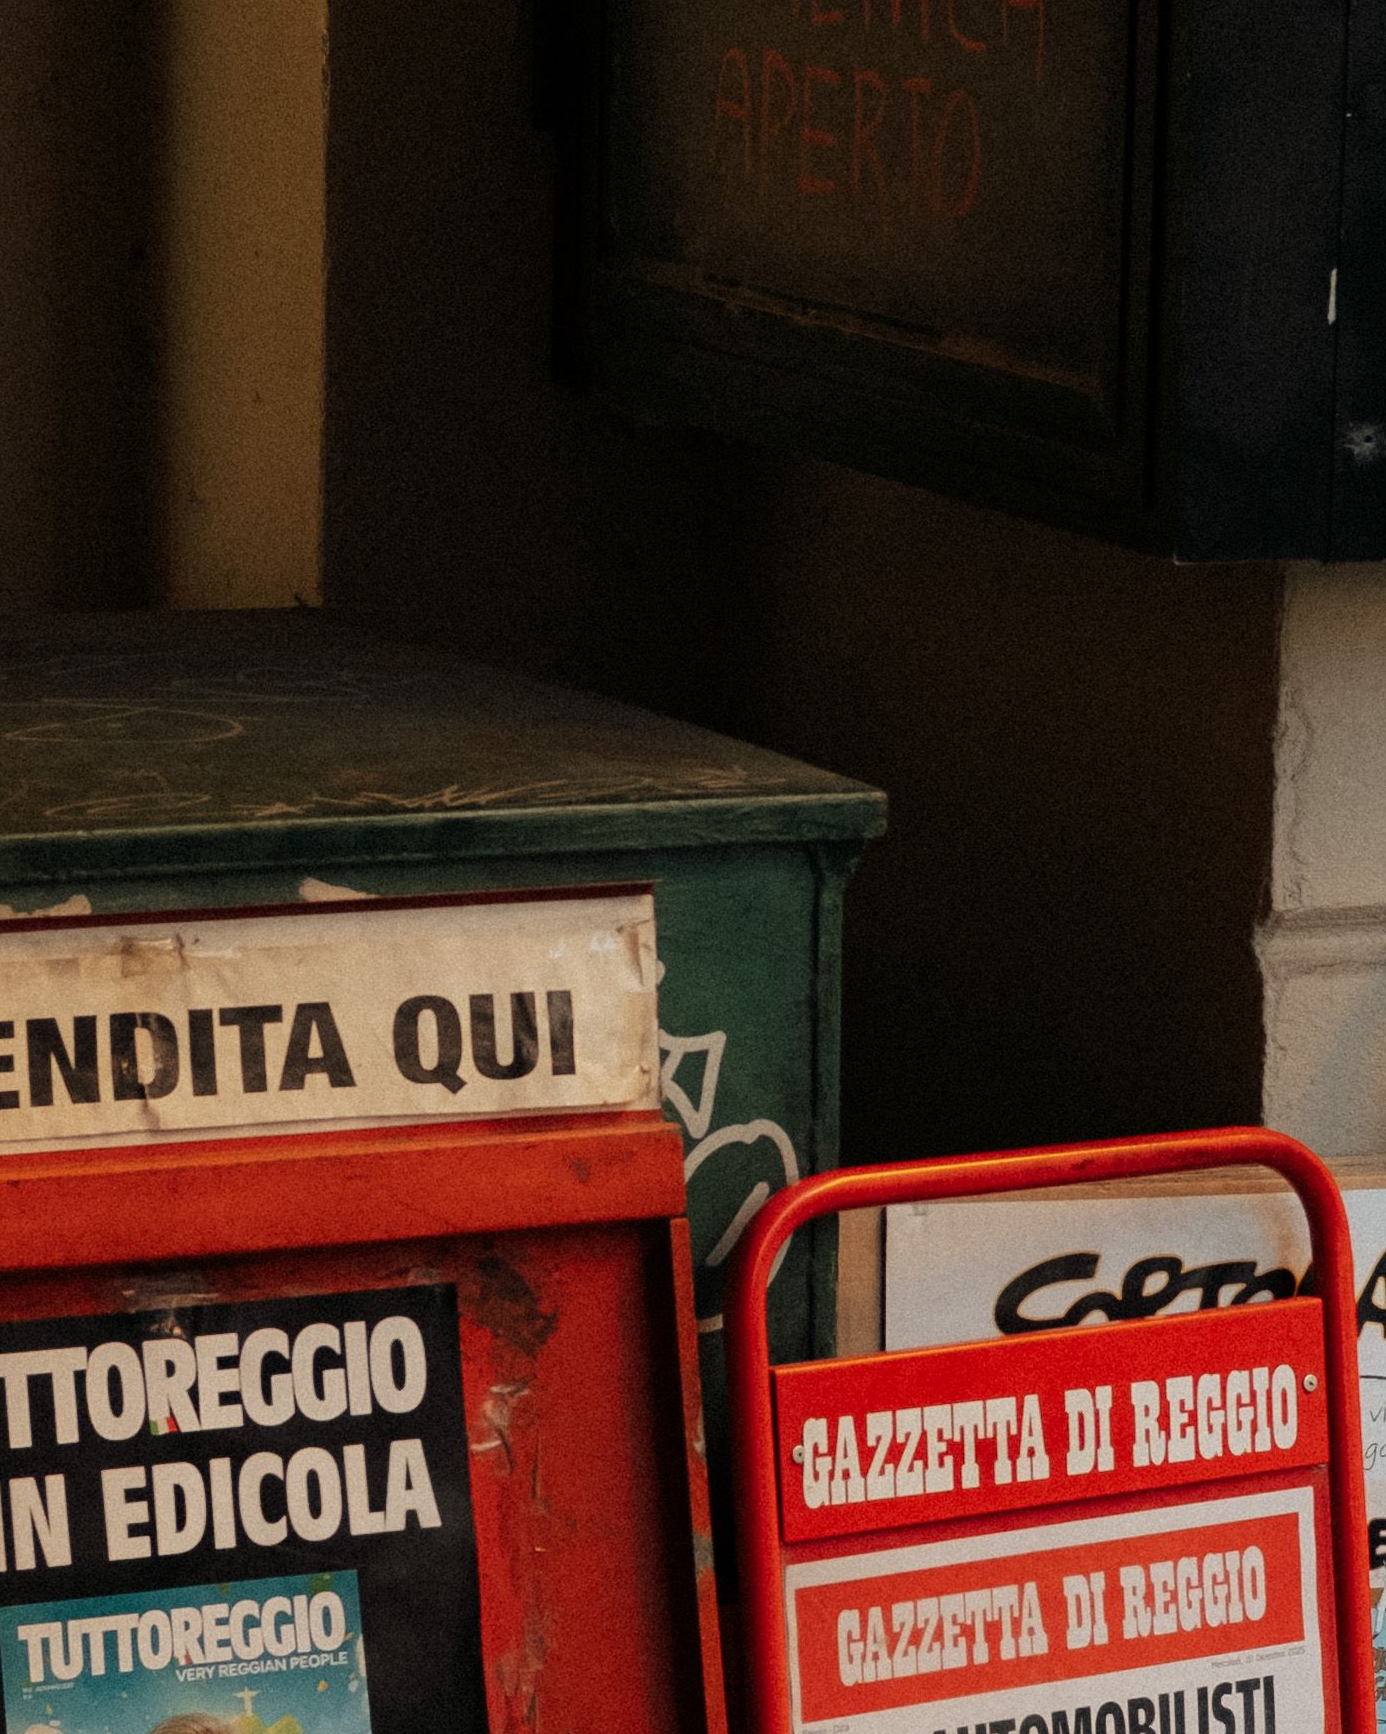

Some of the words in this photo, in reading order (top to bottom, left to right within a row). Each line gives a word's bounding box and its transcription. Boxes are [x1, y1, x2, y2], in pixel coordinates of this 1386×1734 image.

[714, 47, 981, 217] APERTO
[393, 989, 576, 1095] QUI
[803, 1396, 1049, 1509] GAZZETTA
[1065, 1386, 1115, 1476] DI
[1131, 1364, 1298, 1466] REGGIO
[104, 1439, 441, 1562] EDICOLA
[18, 1591, 346, 1683] TUTTOREGGIO
[176, 1666, 215, 1683] VERY
[219, 1658, 287, 1678] REGGIAN
[290, 1652, 348, 1669] PEOPLE
[837, 1583, 1048, 1687] GAZZETTA
[1063, 1564, 1111, 1651] DI
[1119, 1546, 1266, 1641] REGGIO
